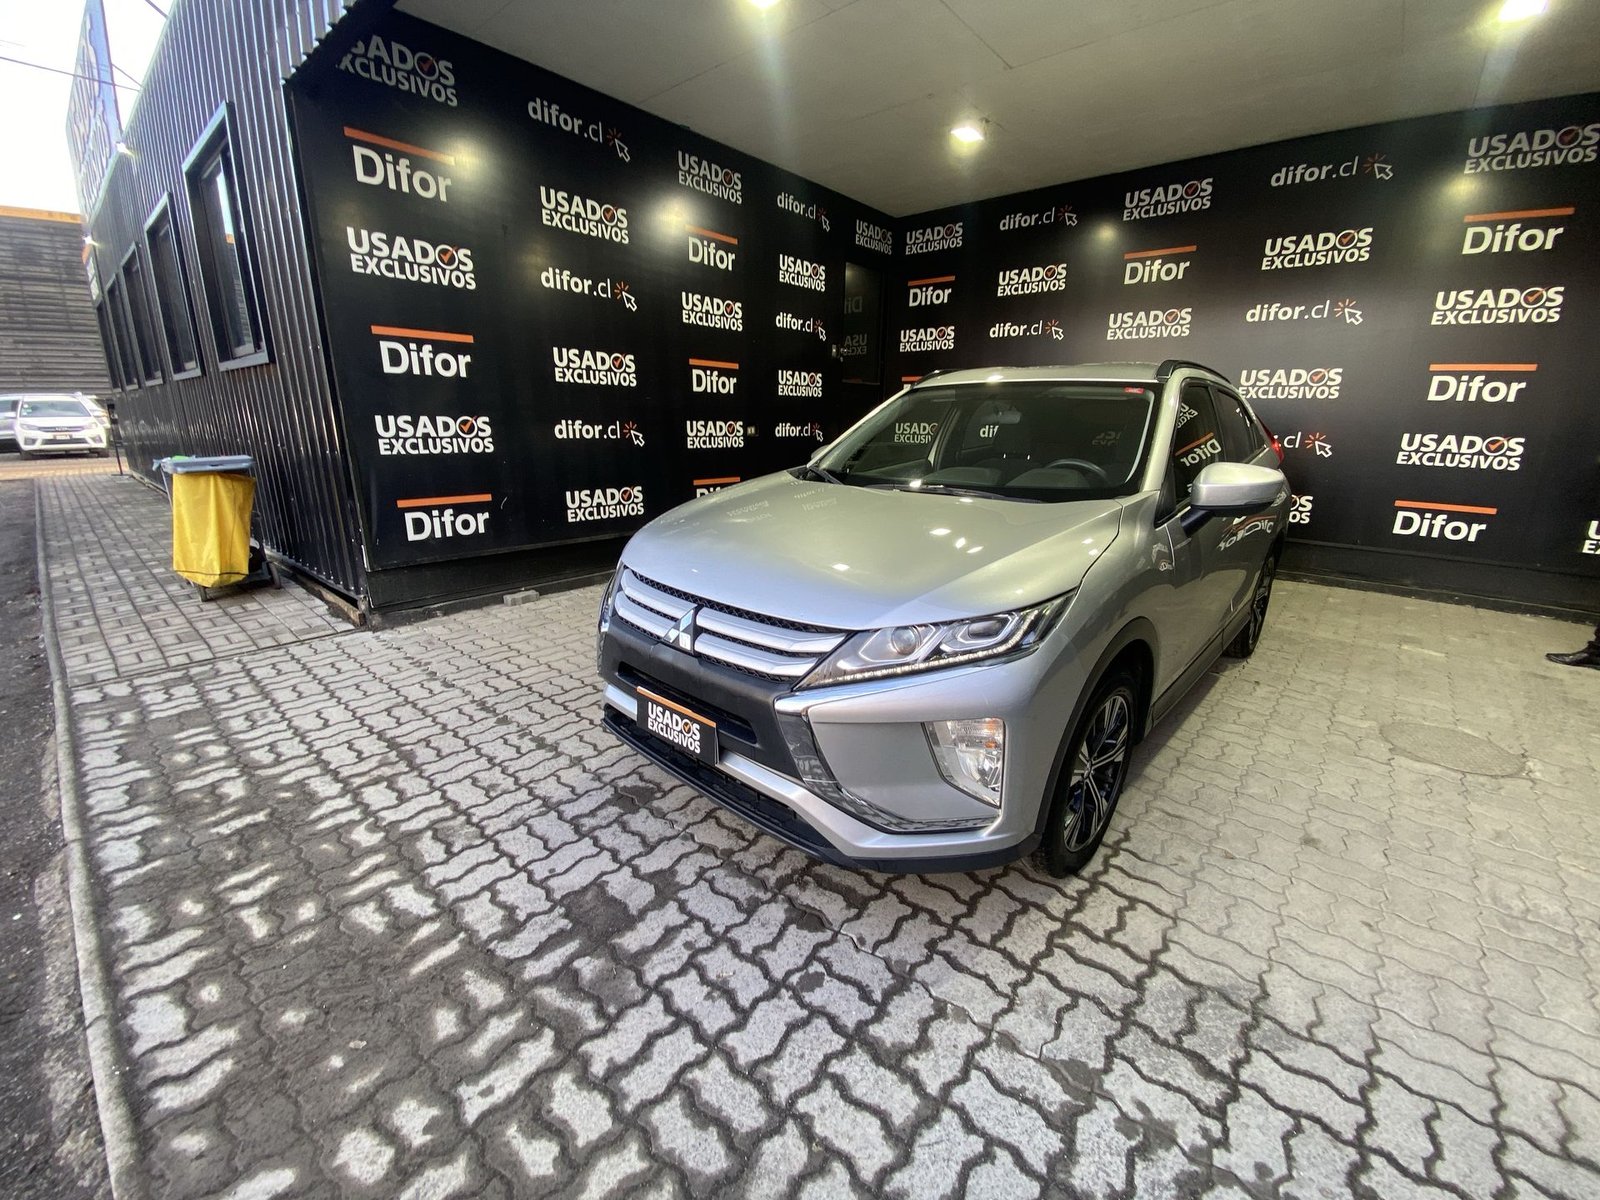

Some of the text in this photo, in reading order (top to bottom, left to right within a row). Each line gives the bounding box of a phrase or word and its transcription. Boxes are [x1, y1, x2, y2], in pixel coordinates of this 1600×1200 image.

[336, 53, 458, 107] XCLUSIVOS
[527, 97, 603, 143] difor.cl
[1468, 123, 1600, 157] USADOS
[678, 151, 742, 190] USADOS
[1270, 156, 1359, 187] difor.cl
[1464, 146, 1598, 174] EXCLUSIVOS
[352, 144, 452, 202] Difor
[678, 171, 742, 204] EXCLUSIVOS
[1125, 178, 1213, 208] USADOS
[540, 186, 628, 229] USADOS
[776, 192, 816, 220] difor.cl
[1123, 196, 1211, 221] EXCLUSIVOS
[542, 208, 629, 244] EXCLUSIVOS
[1000, 206, 1056, 231] difor.cl
[856, 219, 892, 244] USADOS
[906, 222, 963, 244] USADOS
[1264, 228, 1373, 256] USADOS
[1462, 224, 1563, 254] Difor
[347, 227, 474, 272] USADOS
[688, 236, 735, 270] Difor
[856, 234, 892, 255] EXCLUSIVOS
[906, 237, 962, 255] EXCLUSIVOS
[779, 254, 826, 280] USADOS
[1261, 248, 1370, 270] EXCLUSIVOS
[350, 254, 476, 290] EXCLUSIVOS
[541, 267, 611, 298] difor.cl
[779, 270, 826, 292] EXCLUSIVOS
[999, 264, 1067, 286] USADOS
[1124, 258, 1190, 285] Difor
[909, 287, 952, 307] Difor
[997, 279, 1066, 297] EXCLUSIVOS
[1436, 287, 1564, 310] USADOS
[682, 292, 742, 318] USADOS
[1246, 300, 1330, 322] difor.cl
[1431, 308, 1560, 325] EXCLUSIVOS
[682, 310, 742, 331] EXCLUSIVOS
[776, 312, 813, 332] difor.cl
[989, 320, 1042, 338] difor.cl
[1109, 308, 1192, 329] USADOS
[900, 326, 955, 343] USADOS
[1106, 324, 1190, 340] EXCLUSIVOS
[900, 340, 954, 352] EXCLUSIVOS
[379, 340, 471, 378] Difor
[553, 347, 635, 374] USADOS
[554, 367, 637, 387] EXCLUSIVOS
[692, 369, 736, 394] Difor
[778, 370, 822, 387] USADOS
[1241, 368, 1343, 386] USADOS
[1427, 375, 1526, 402] Difor
[778, 385, 822, 398] EXCLUSIVOS
[374, 415, 492, 438] USADOS
[554, 420, 620, 440] difor.cl
[686, 420, 744, 436] USADOS
[775, 423, 810, 437] difor.cl
[378, 438, 494, 455] EXCLUSIVOS
[687, 436, 744, 449] EXCLUSIVOS
[1400, 433, 1525, 456] USADOS
[1396, 452, 1521, 471] EXCLUSIVOS
[566, 486, 643, 508] USADOS
[568, 502, 644, 522] EXCLUSIVOS
[404, 510, 490, 541] Difor
[1392, 510, 1486, 542] Difor
[648, 702, 700, 740] USADOS
[648, 718, 700, 754] EXCLUSIVOS
